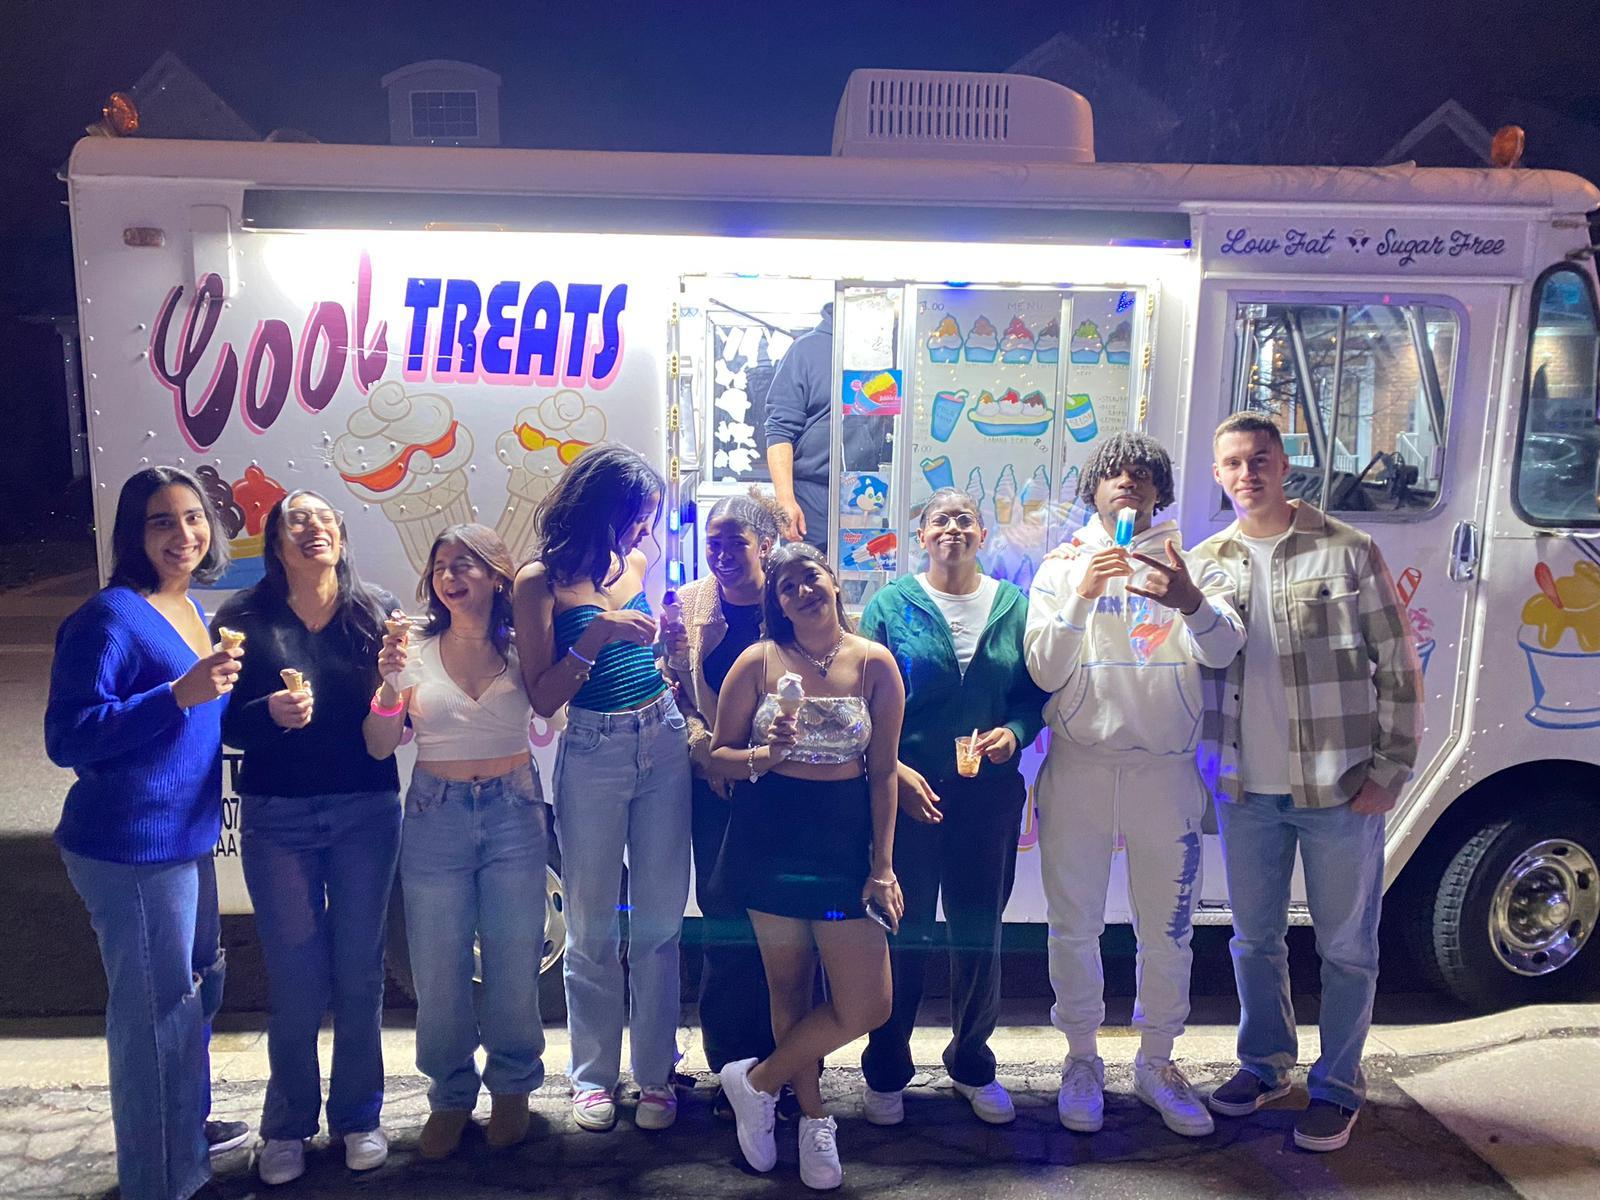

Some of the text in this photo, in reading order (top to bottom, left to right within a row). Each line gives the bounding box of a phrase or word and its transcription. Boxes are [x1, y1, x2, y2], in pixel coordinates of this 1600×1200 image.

[1221, 228, 1505, 267] Low Fat Sugar Free
[150, 248, 628, 454] Cool TREATS
